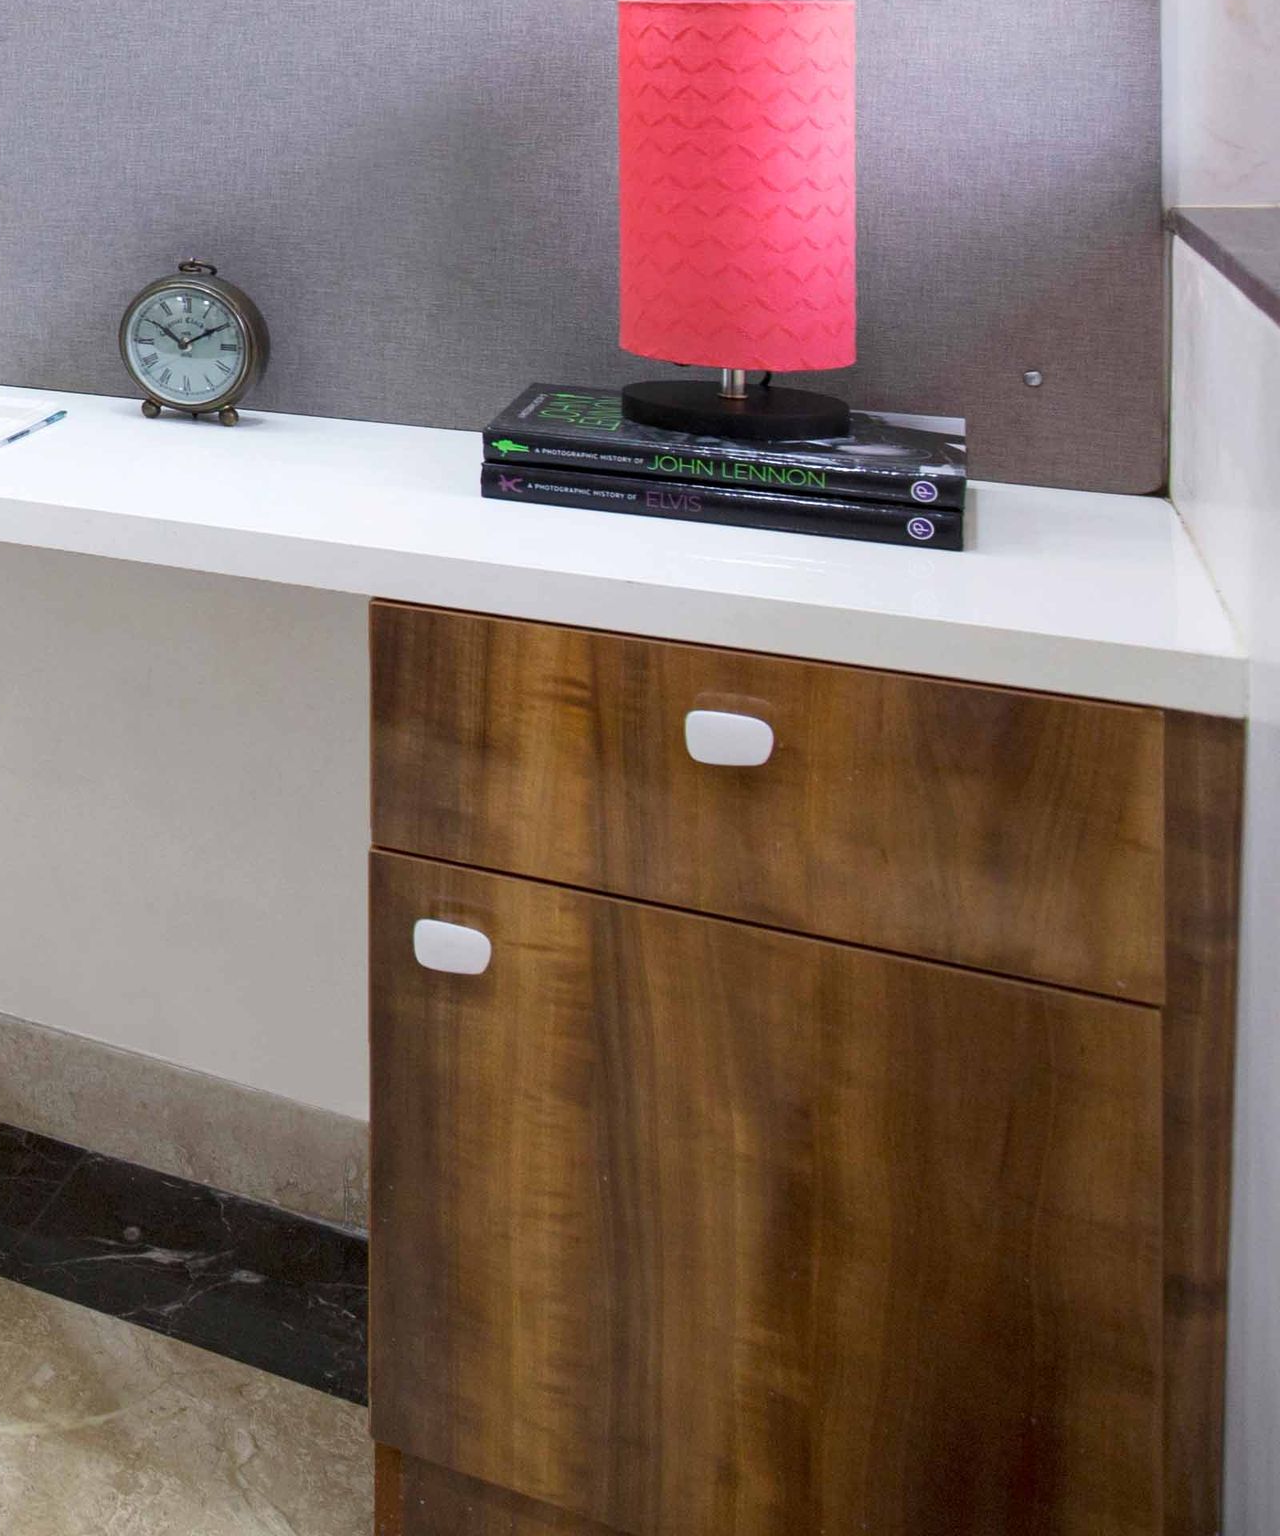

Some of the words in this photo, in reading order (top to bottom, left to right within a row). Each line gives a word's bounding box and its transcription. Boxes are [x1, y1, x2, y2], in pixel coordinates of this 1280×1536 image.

[542, 448, 598, 460] PHOTOGRAPHIC
[600, 454, 632, 463] HISTORY
[647, 455, 714, 476] JOHN
[722, 462, 826, 489] LENNON
[535, 483, 591, 496] PHOTOGRAPHIC
[593, 489, 625, 499] HISTORY
[646, 490, 702, 512] ELVIS
